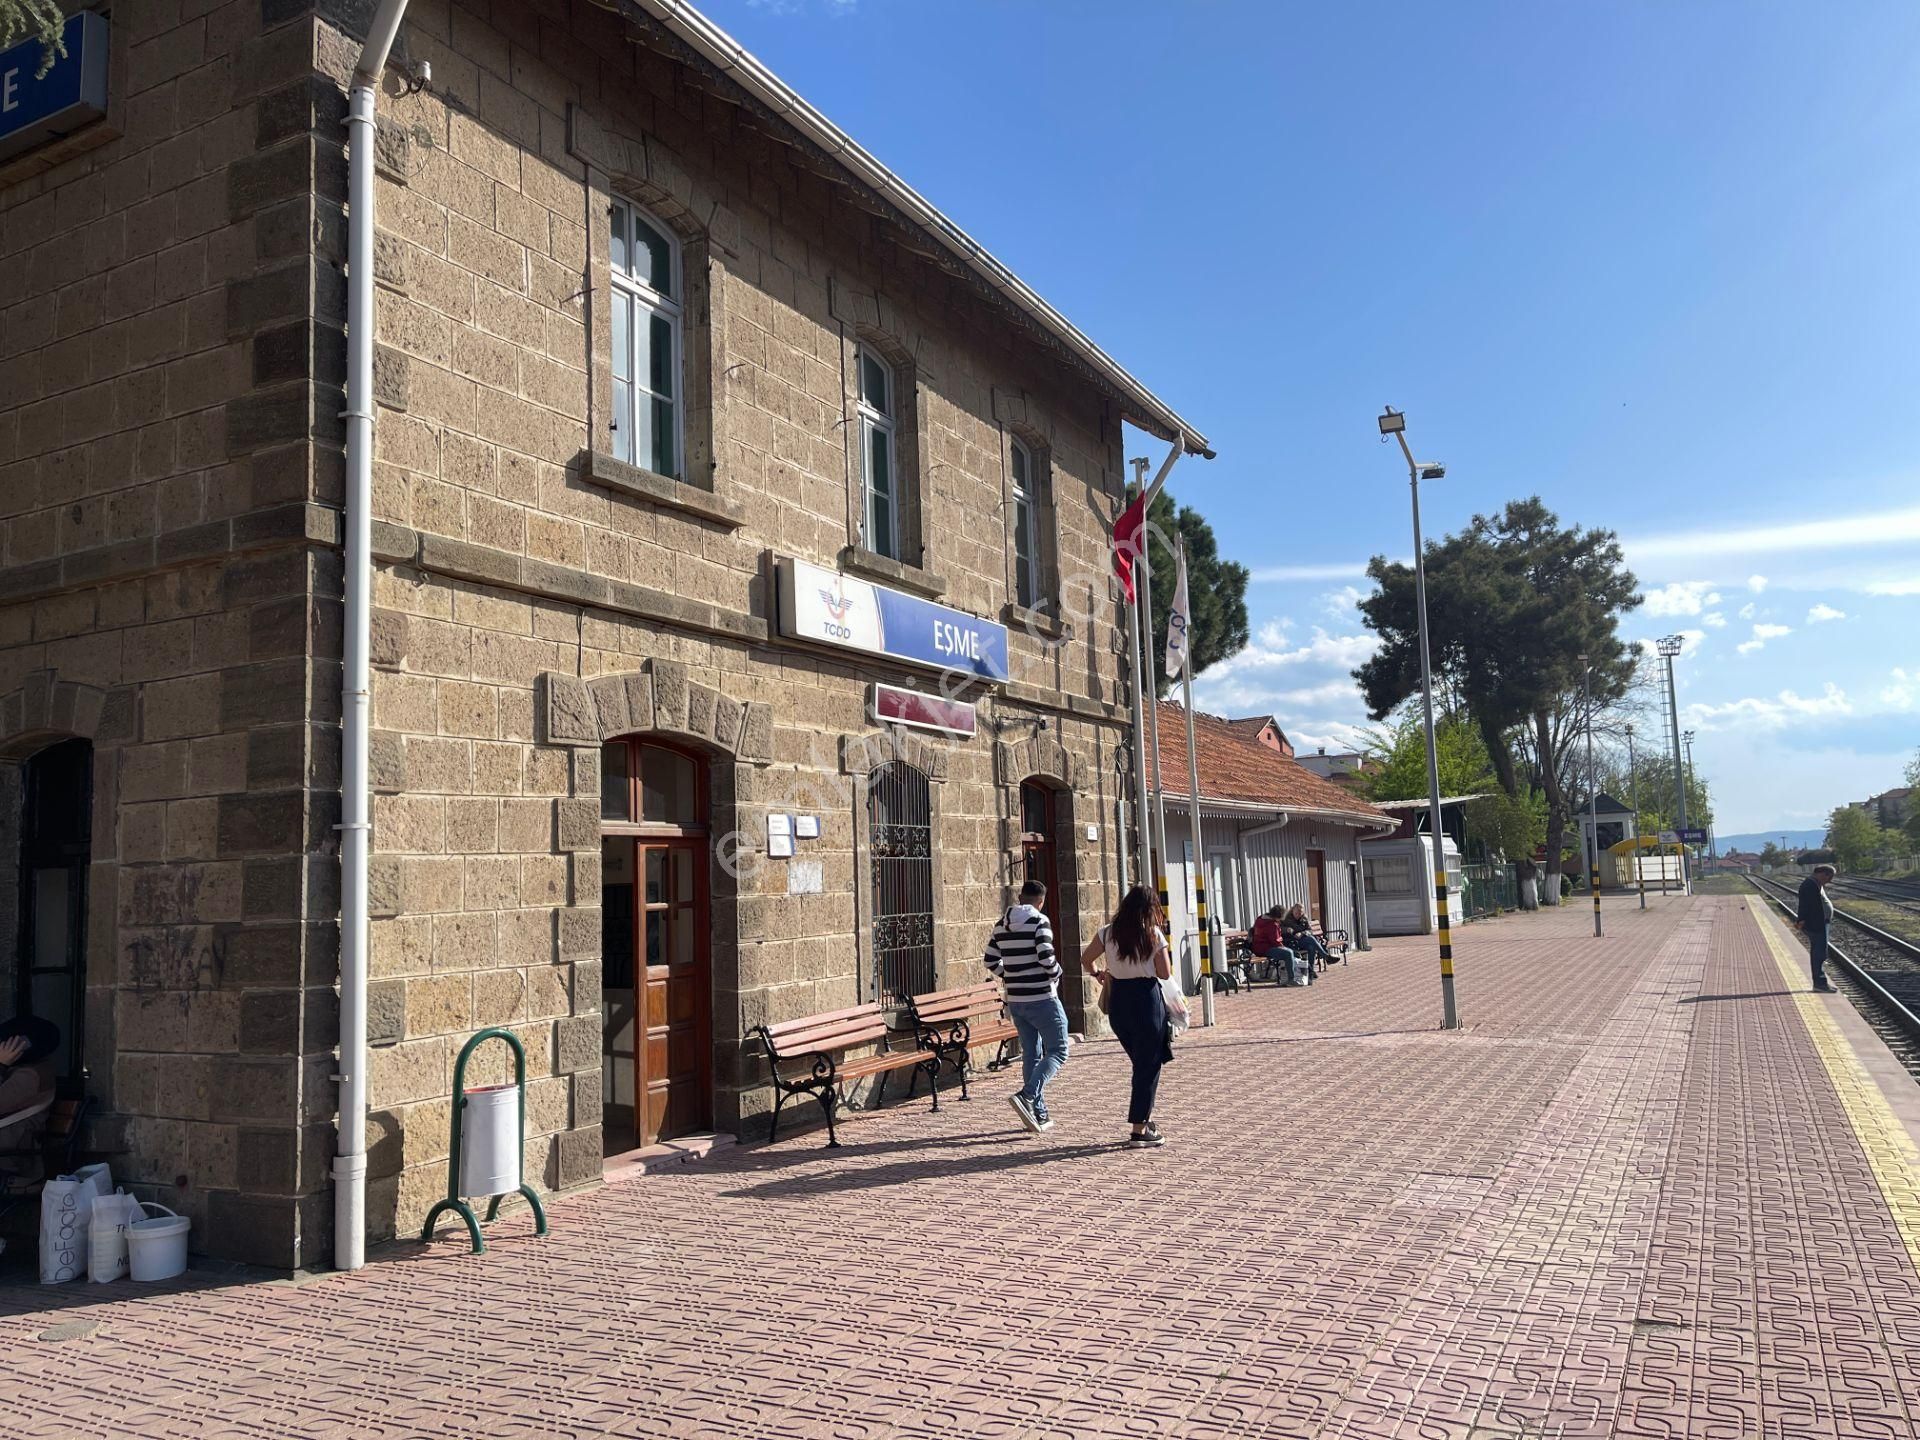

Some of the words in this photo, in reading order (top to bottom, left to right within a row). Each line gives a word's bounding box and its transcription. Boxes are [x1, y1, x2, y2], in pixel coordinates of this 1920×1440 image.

[824, 621, 851, 639] TCDD
[934, 619, 980, 660] EŞME
[55, 1193, 77, 1281] DeFacto
